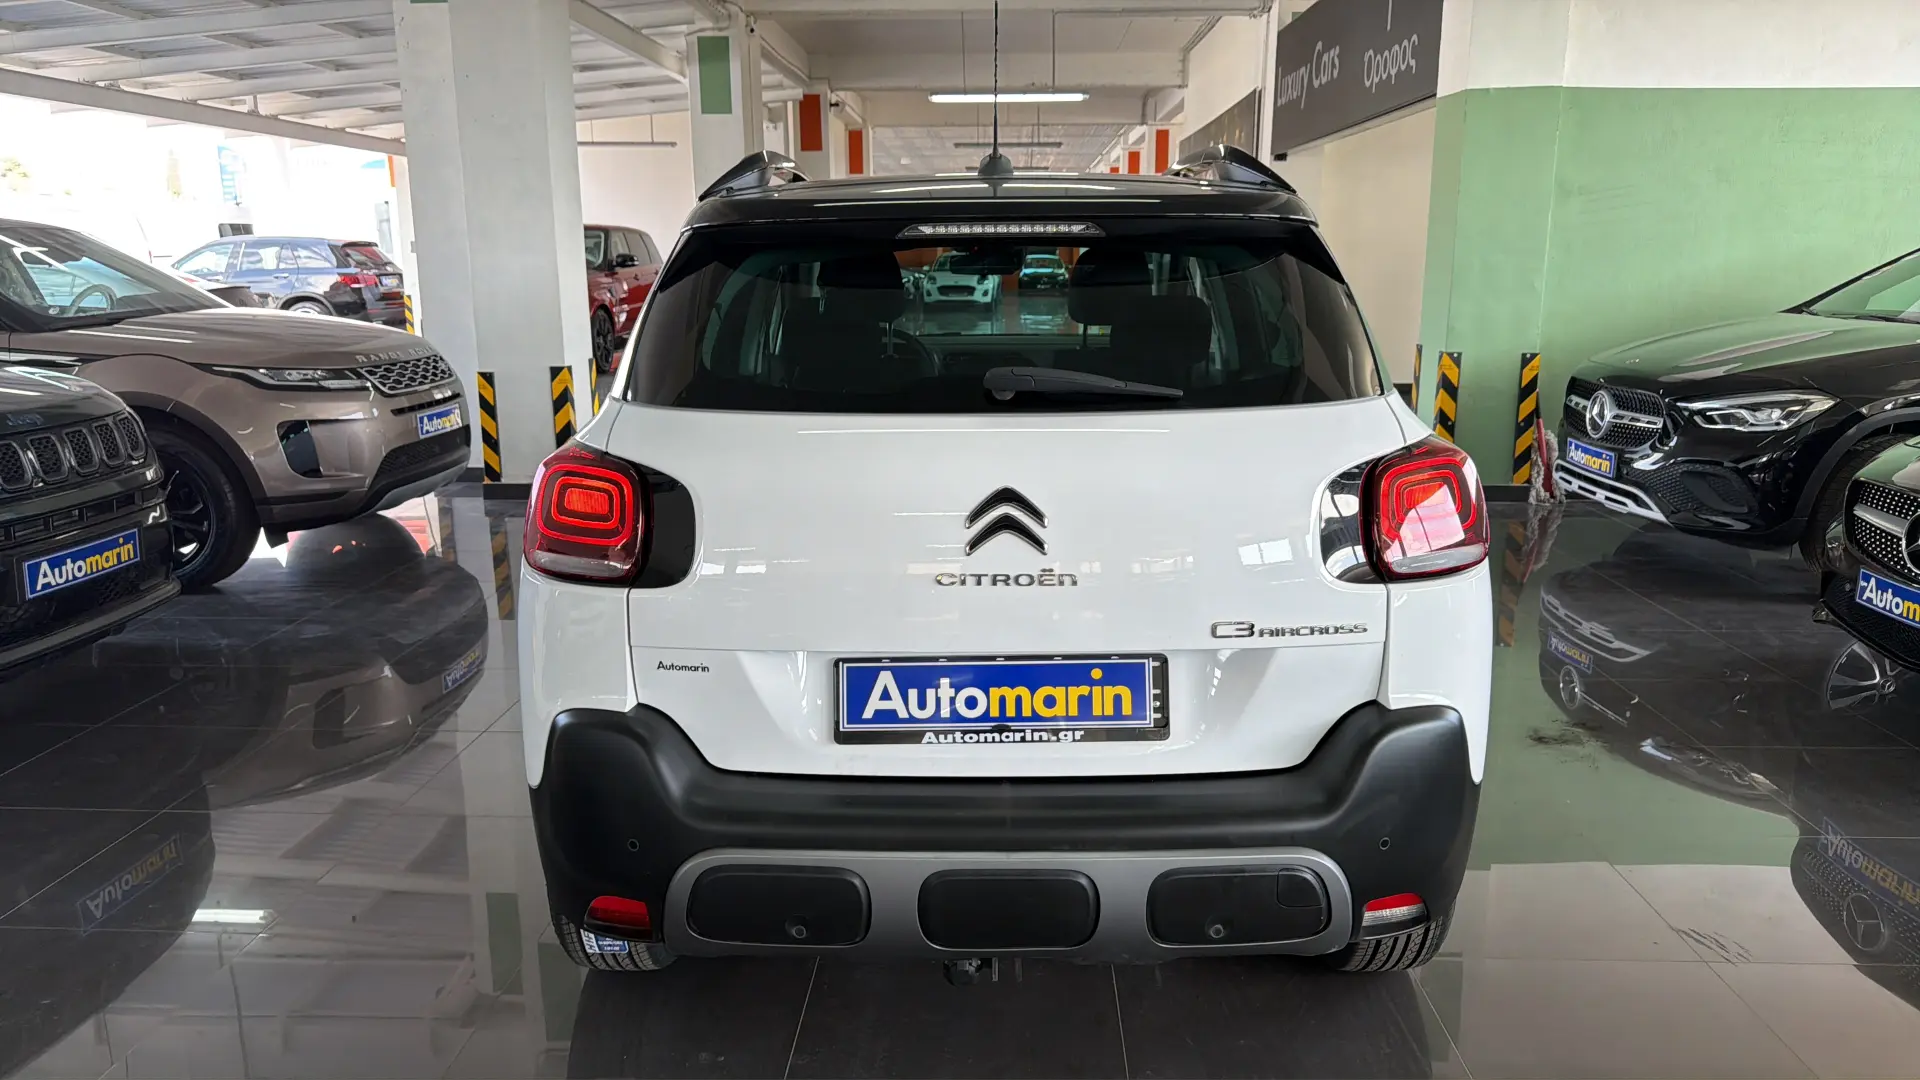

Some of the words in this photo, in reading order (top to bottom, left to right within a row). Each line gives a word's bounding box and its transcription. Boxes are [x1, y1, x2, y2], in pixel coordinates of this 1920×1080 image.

[1277, 63, 1311, 109] Luxury
[1312, 40, 1340, 88] Cars
[1364, 34, 1418, 93] Όροφος
[1569, 442, 1611, 473] Automarin
[36, 537, 134, 591] Automarin
[1211, 621, 1255, 638] C3
[1258, 623, 1368, 637] AIRCROSS
[656, 660, 710, 673] Automarin
[861, 668, 1132, 719] Automarin
[921, 729, 1084, 744] Automarin.gr
